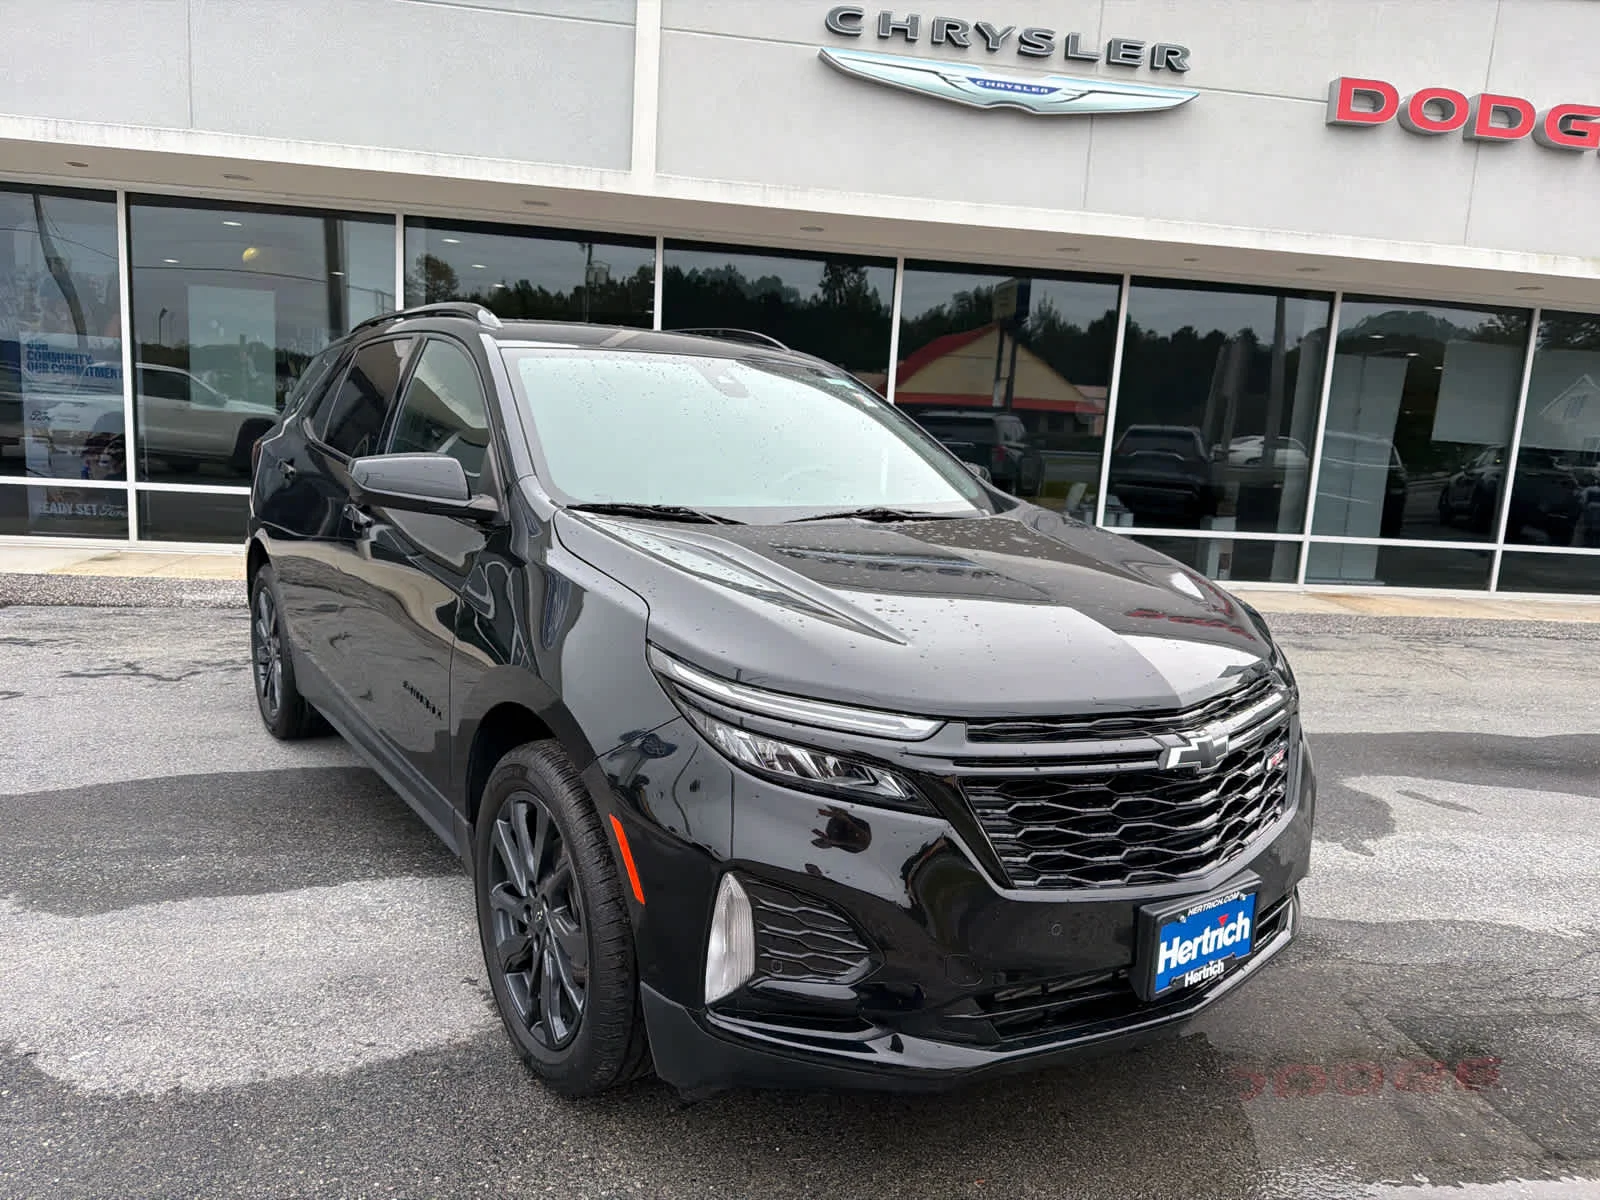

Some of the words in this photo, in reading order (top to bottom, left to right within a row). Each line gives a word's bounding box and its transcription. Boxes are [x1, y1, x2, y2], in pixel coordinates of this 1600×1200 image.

[824, 4, 1192, 73] CHRYSLER
[975, 80, 1049, 94] CHRYSLER
[1325, 76, 1600, 154] DODG
[1157, 911, 1250, 974] Hertrich
[1184, 960, 1224, 987] Hertrich
